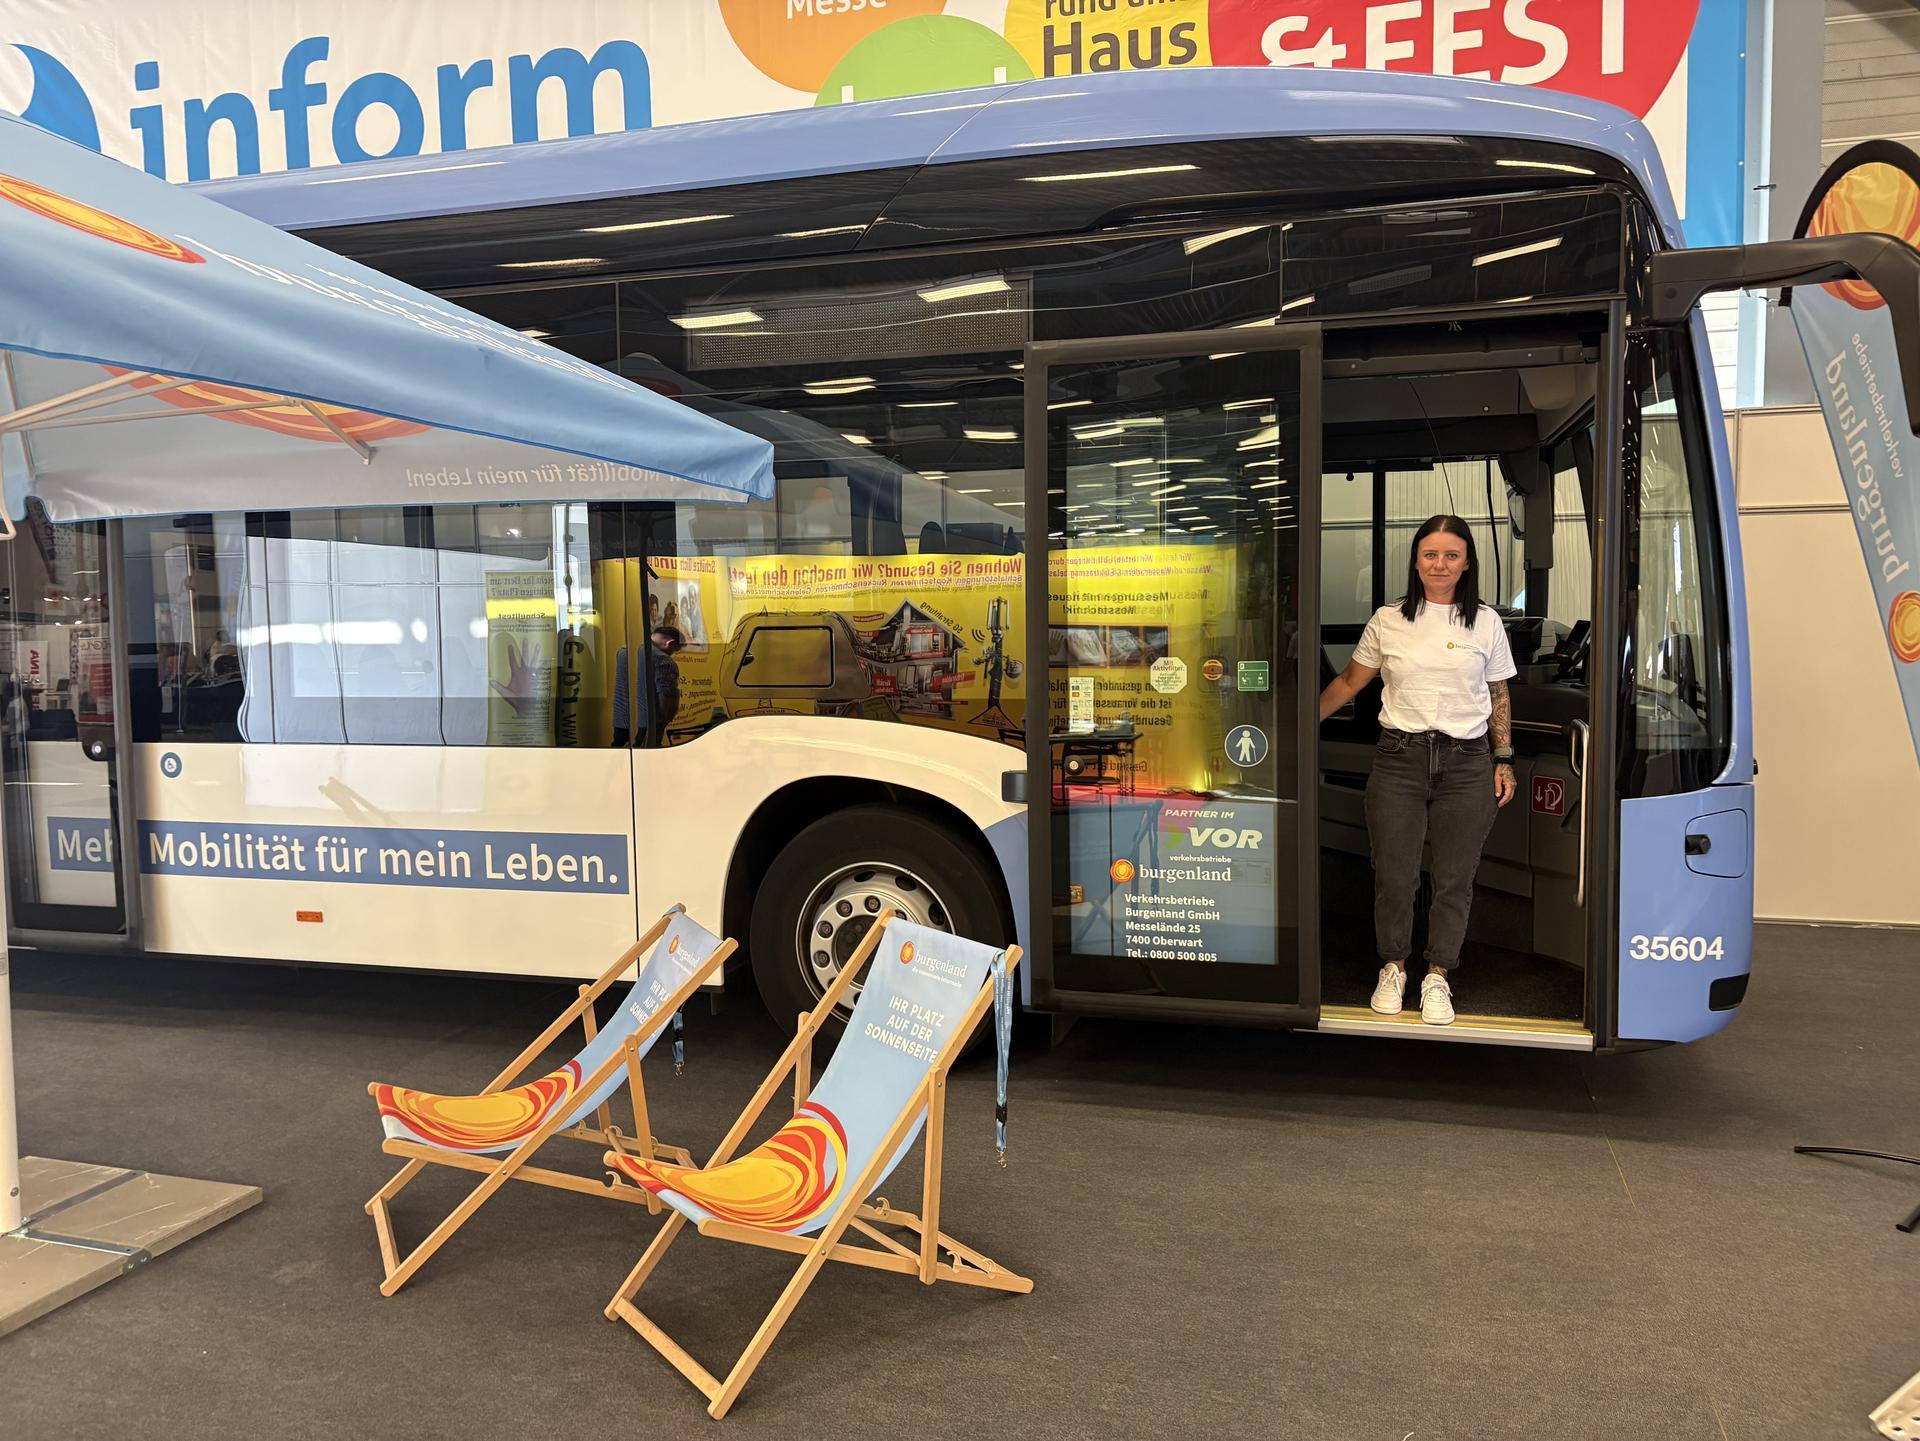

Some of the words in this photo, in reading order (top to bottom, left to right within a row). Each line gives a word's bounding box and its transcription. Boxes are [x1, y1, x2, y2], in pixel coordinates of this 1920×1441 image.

[1043, 21, 1197, 79] Haus
[130, 36, 652, 183] inform
[1165, 809, 1220, 818] PARTNER
[1221, 810, 1235, 819] IM
[1188, 826, 1263, 849] VOR
[150, 832, 306, 871] Mobilität
[315, 835, 368, 873] für
[379, 840, 471, 878] mein
[484, 843, 618, 884] Leben.
[1169, 853, 1232, 863] verkehrsbetriebe
[1139, 864, 1232, 883] burgenland
[1125, 894, 1216, 906] Verkehrsbetriebe
[1125, 907, 1185, 919] Burgenland
[1187, 910, 1220, 921] GmbH
[1125, 921, 1186, 933] Messelände
[1187, 924, 1201, 933] 25
[1125, 934, 1151, 945] 7400
[1152, 936, 1203, 948] Oberwart
[1629, 934, 1724, 961] 35604
[915, 950, 967, 978] burgenland
[1125, 948, 1148, 958] Tel.:
[1150, 949, 1175, 960] 0800
[1177, 951, 1196, 961] 500
[1198, 952, 1217, 962] 805
[888, 995, 909, 1014] IHR
[910, 1004, 945, 1027] PLATZ
[886, 1014, 910, 1032] AUF
[911, 1024, 933, 1042] DER
[865, 1023, 938, 1063] SONNENSEITE
